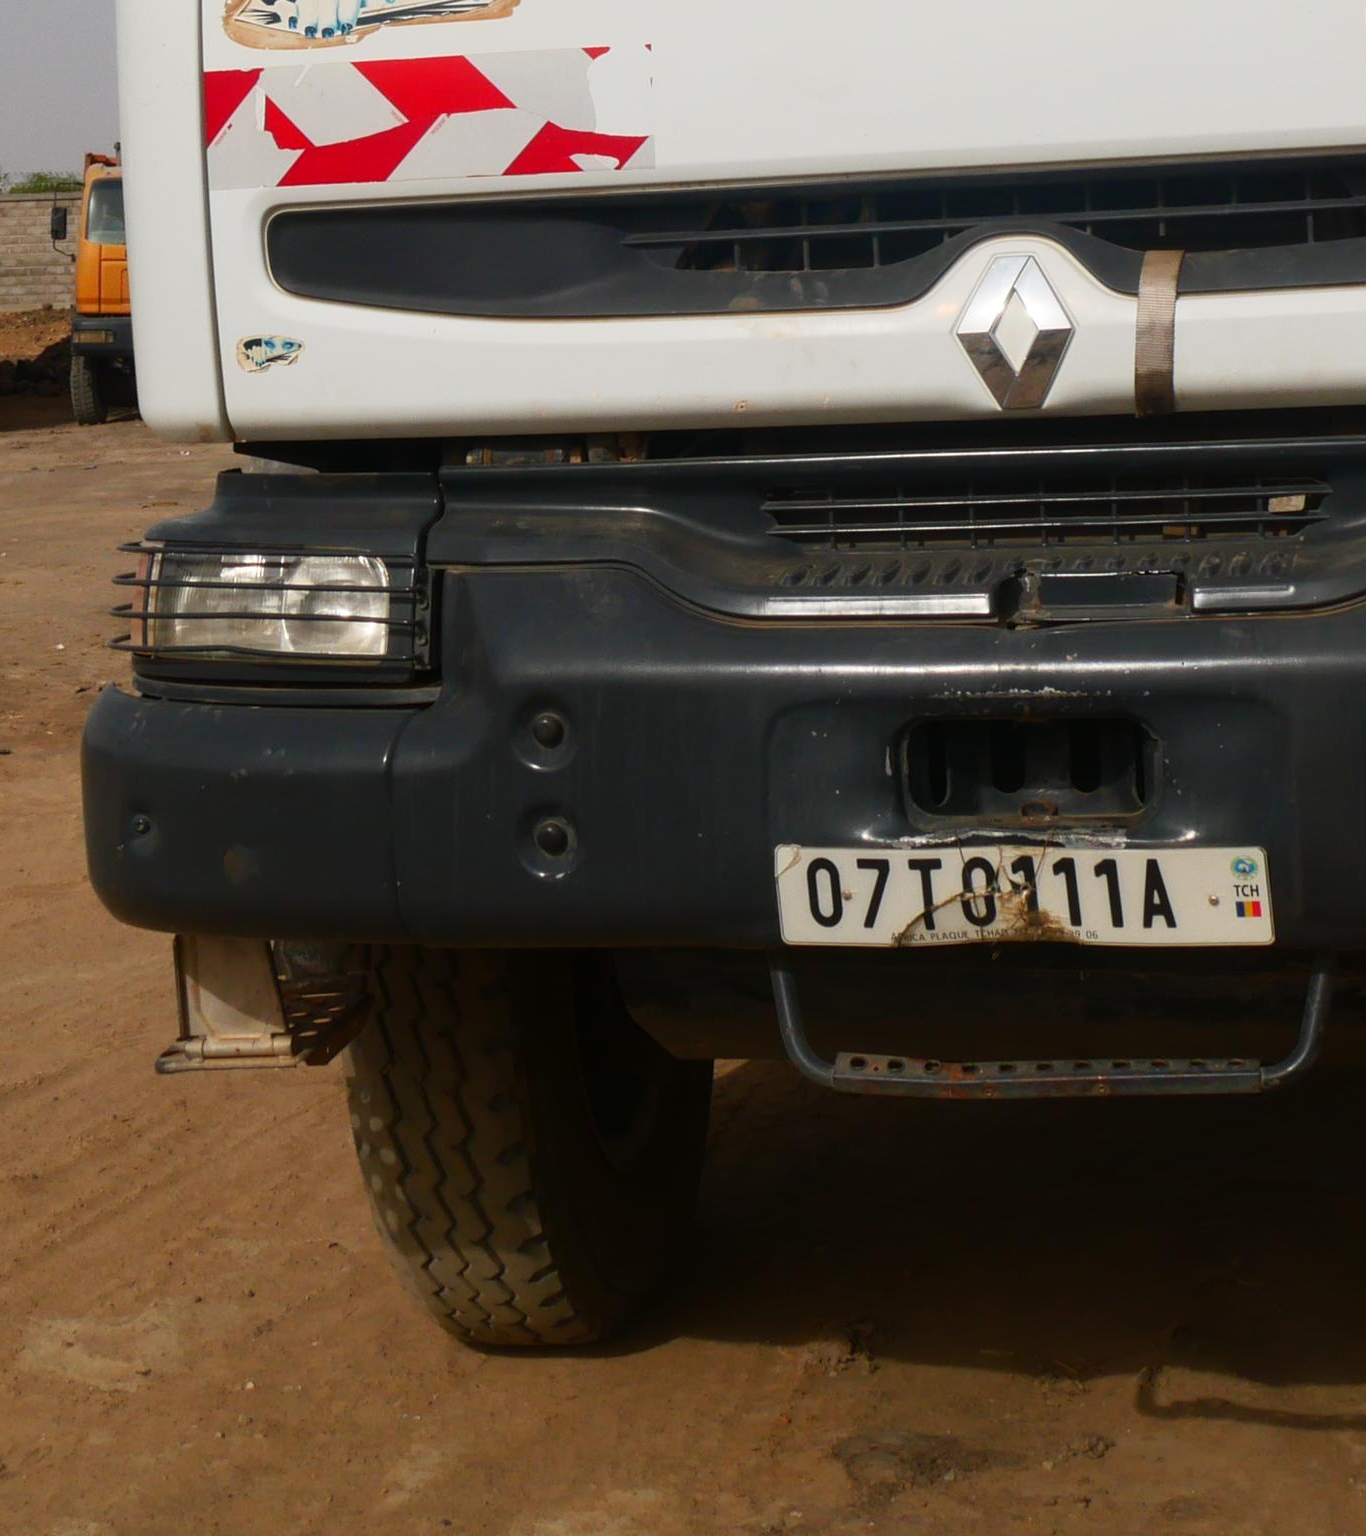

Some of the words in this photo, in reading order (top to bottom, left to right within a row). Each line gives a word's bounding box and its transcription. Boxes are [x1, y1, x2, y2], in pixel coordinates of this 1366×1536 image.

[1233, 884, 1260, 897] TCH
[930, 931, 969, 941] PLAQUE
[1085, 930, 1099, 940] 06
